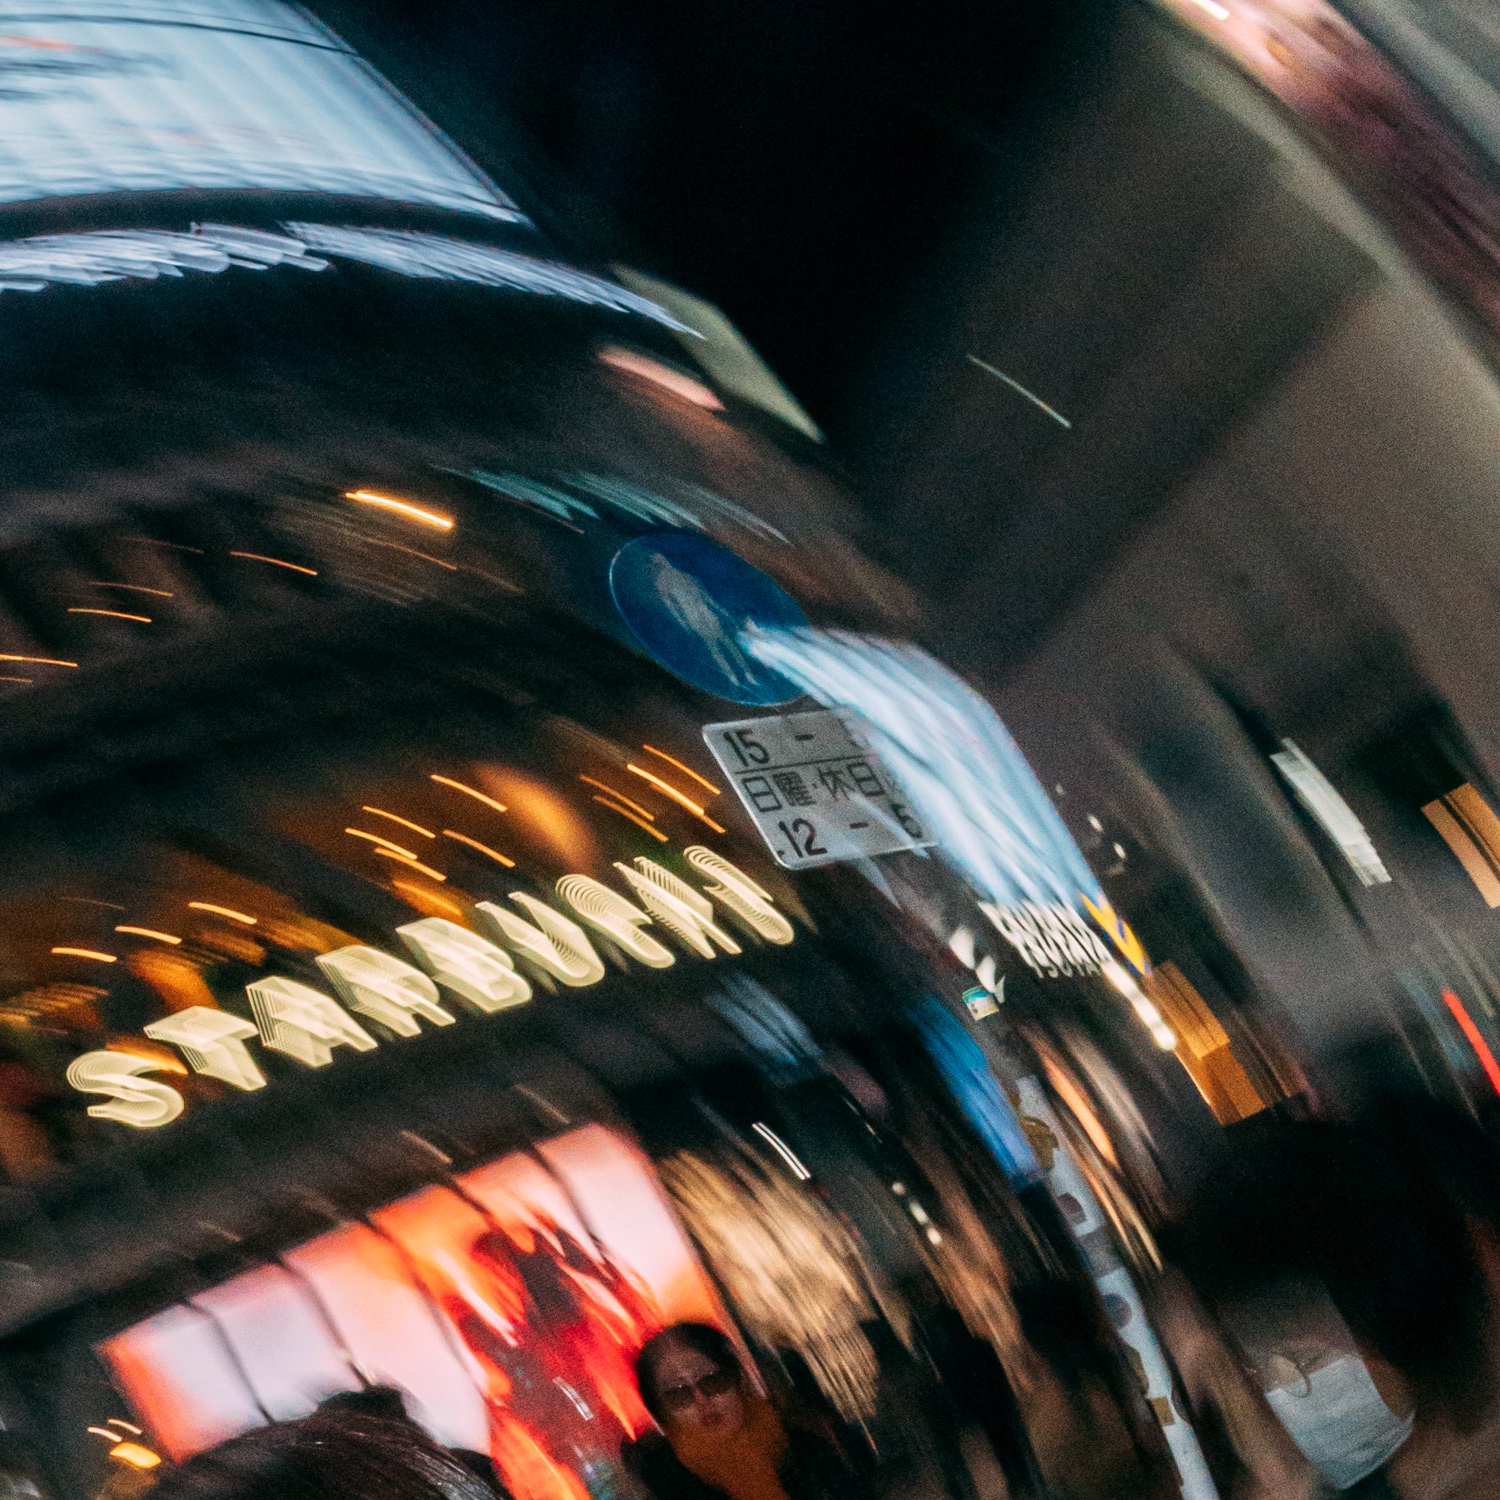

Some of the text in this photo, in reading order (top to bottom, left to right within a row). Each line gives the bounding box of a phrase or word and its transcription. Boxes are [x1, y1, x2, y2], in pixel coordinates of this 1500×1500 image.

[723, 728, 770, 768] 15
[777, 817, 828, 858] 12
[66, 846, 795, 1129] STARBUCKS
